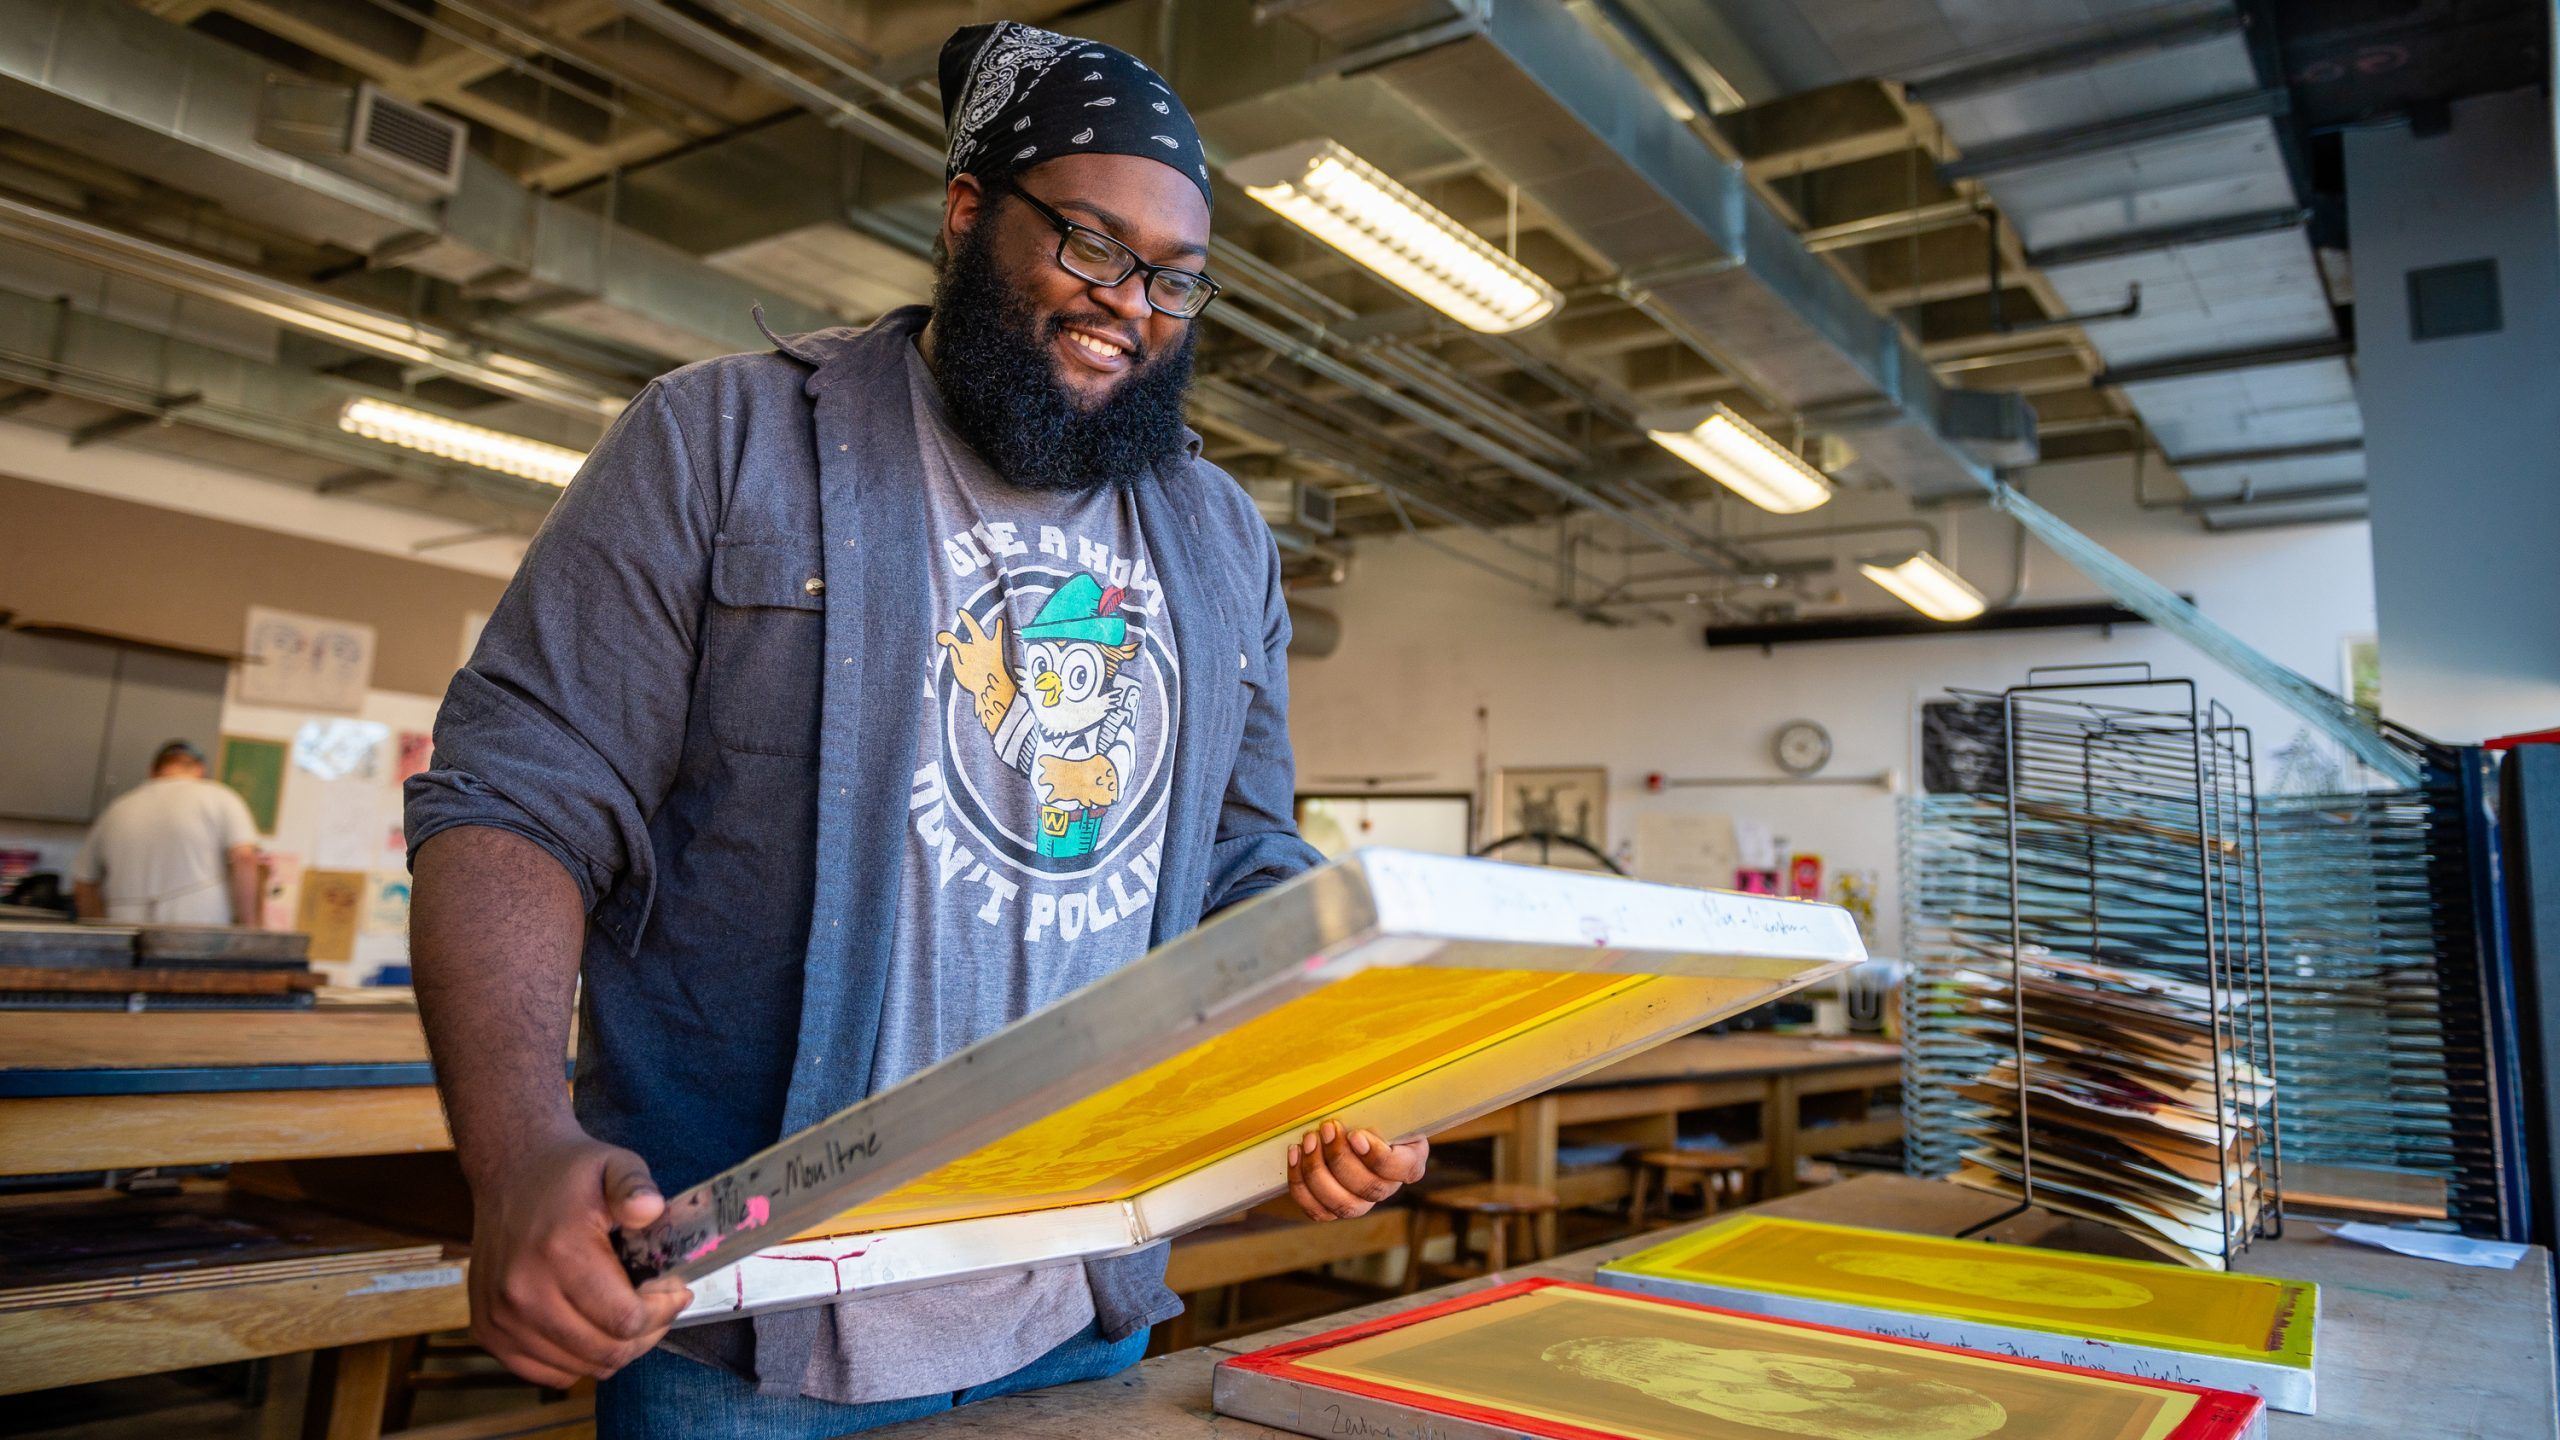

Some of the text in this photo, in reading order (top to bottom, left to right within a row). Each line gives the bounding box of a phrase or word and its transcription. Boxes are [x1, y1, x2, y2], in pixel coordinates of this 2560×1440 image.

[943, 520, 1028, 577] GIVE
[1038, 525, 1067, 560] A
[1045, 812, 1065, 831] W
